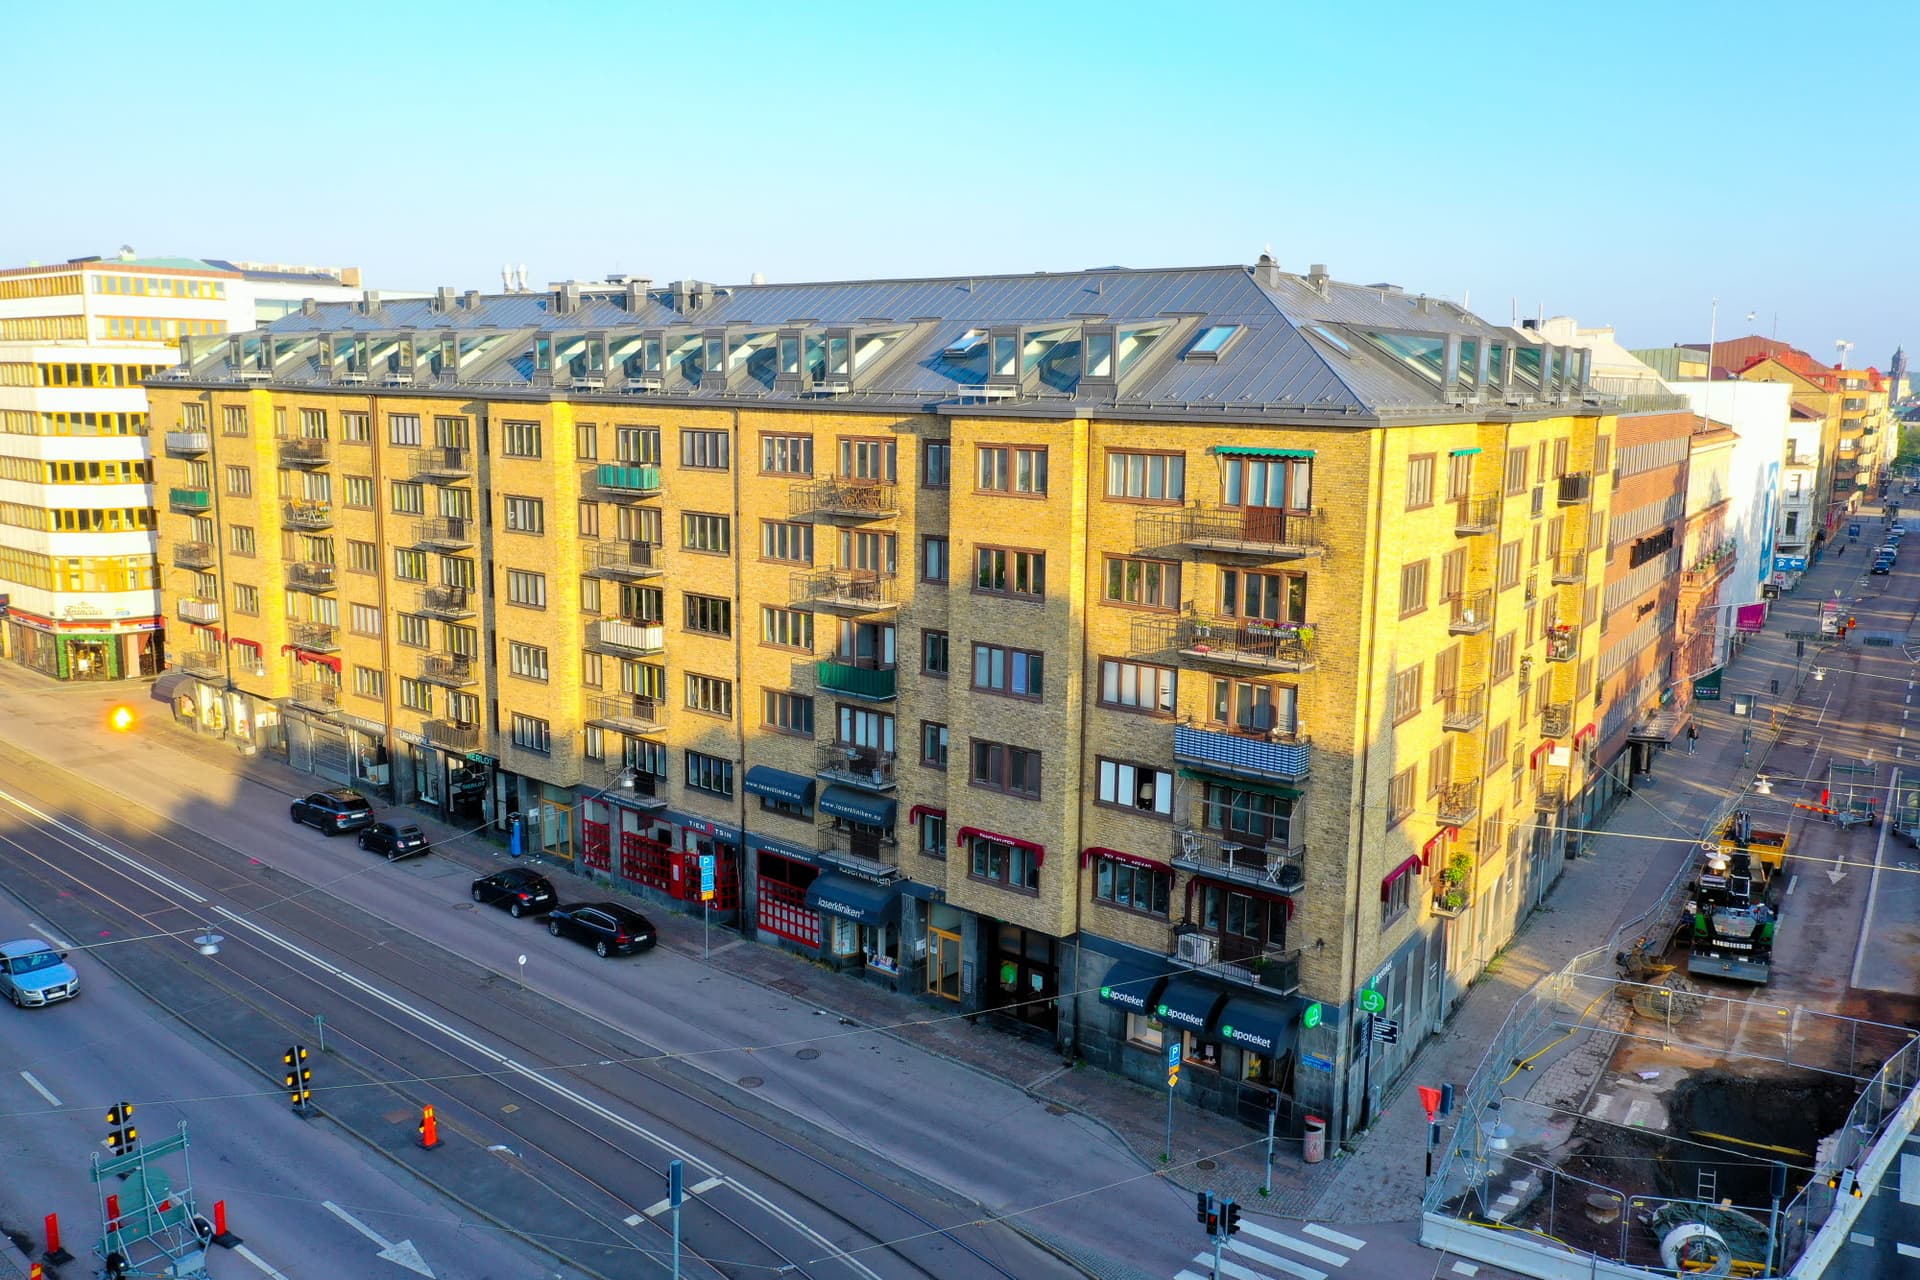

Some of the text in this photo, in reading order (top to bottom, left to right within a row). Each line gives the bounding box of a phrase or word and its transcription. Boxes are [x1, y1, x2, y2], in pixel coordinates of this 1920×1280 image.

[466, 752, 493, 766] MERLOT
[688, 820, 732, 839] TIEN TSIN
[1109, 989, 1144, 1008] apoteket
[1167, 1008, 1203, 1027] apoteket
[1232, 1028, 1271, 1049] apoteket
